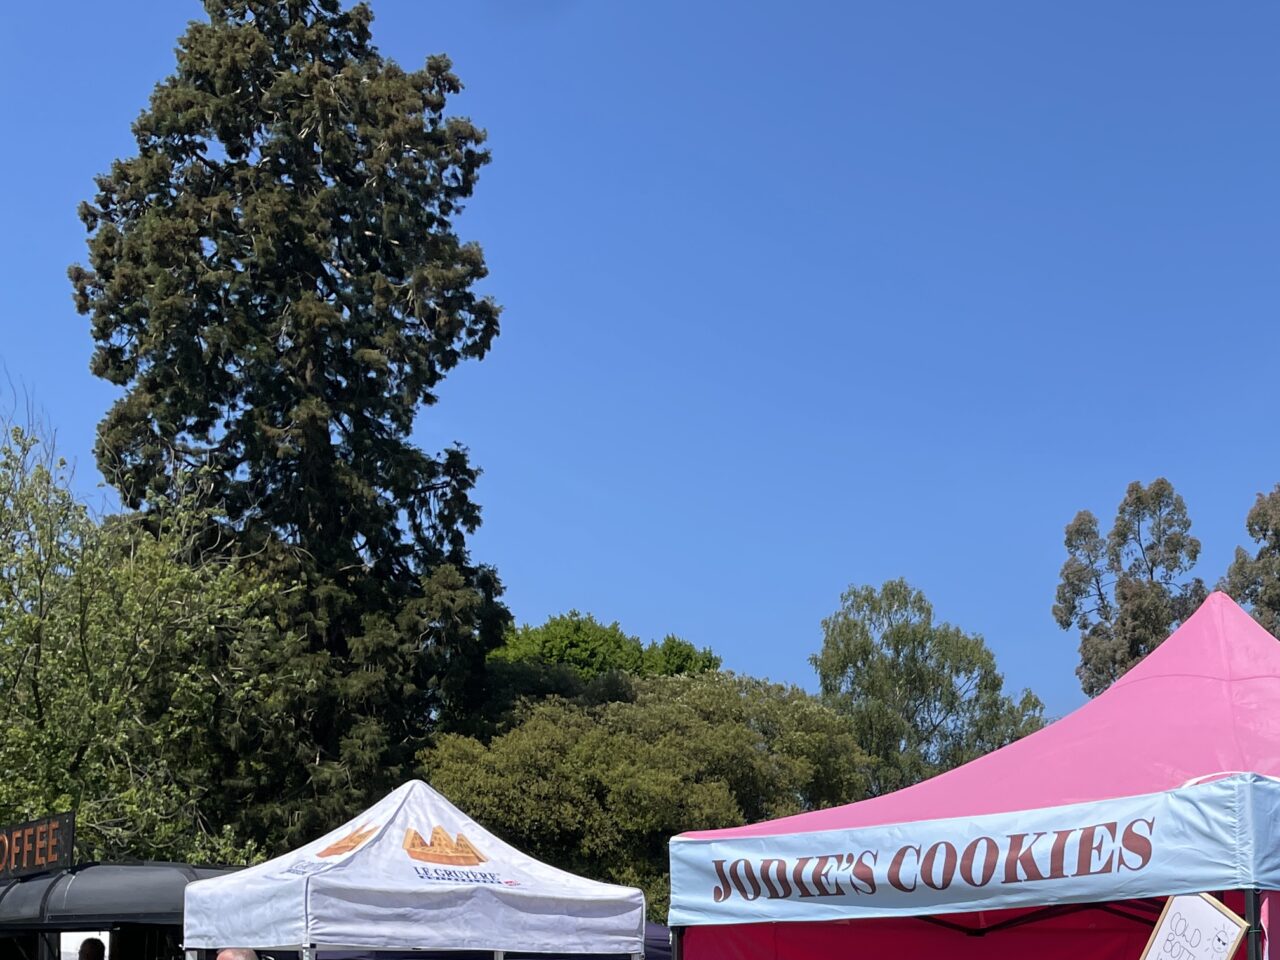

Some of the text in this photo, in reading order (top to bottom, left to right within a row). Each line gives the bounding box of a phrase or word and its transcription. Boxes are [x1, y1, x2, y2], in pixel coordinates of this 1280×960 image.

[712, 816, 1155, 902] JODIE'S COOKIES
[1170, 912, 1201, 948] COLD
